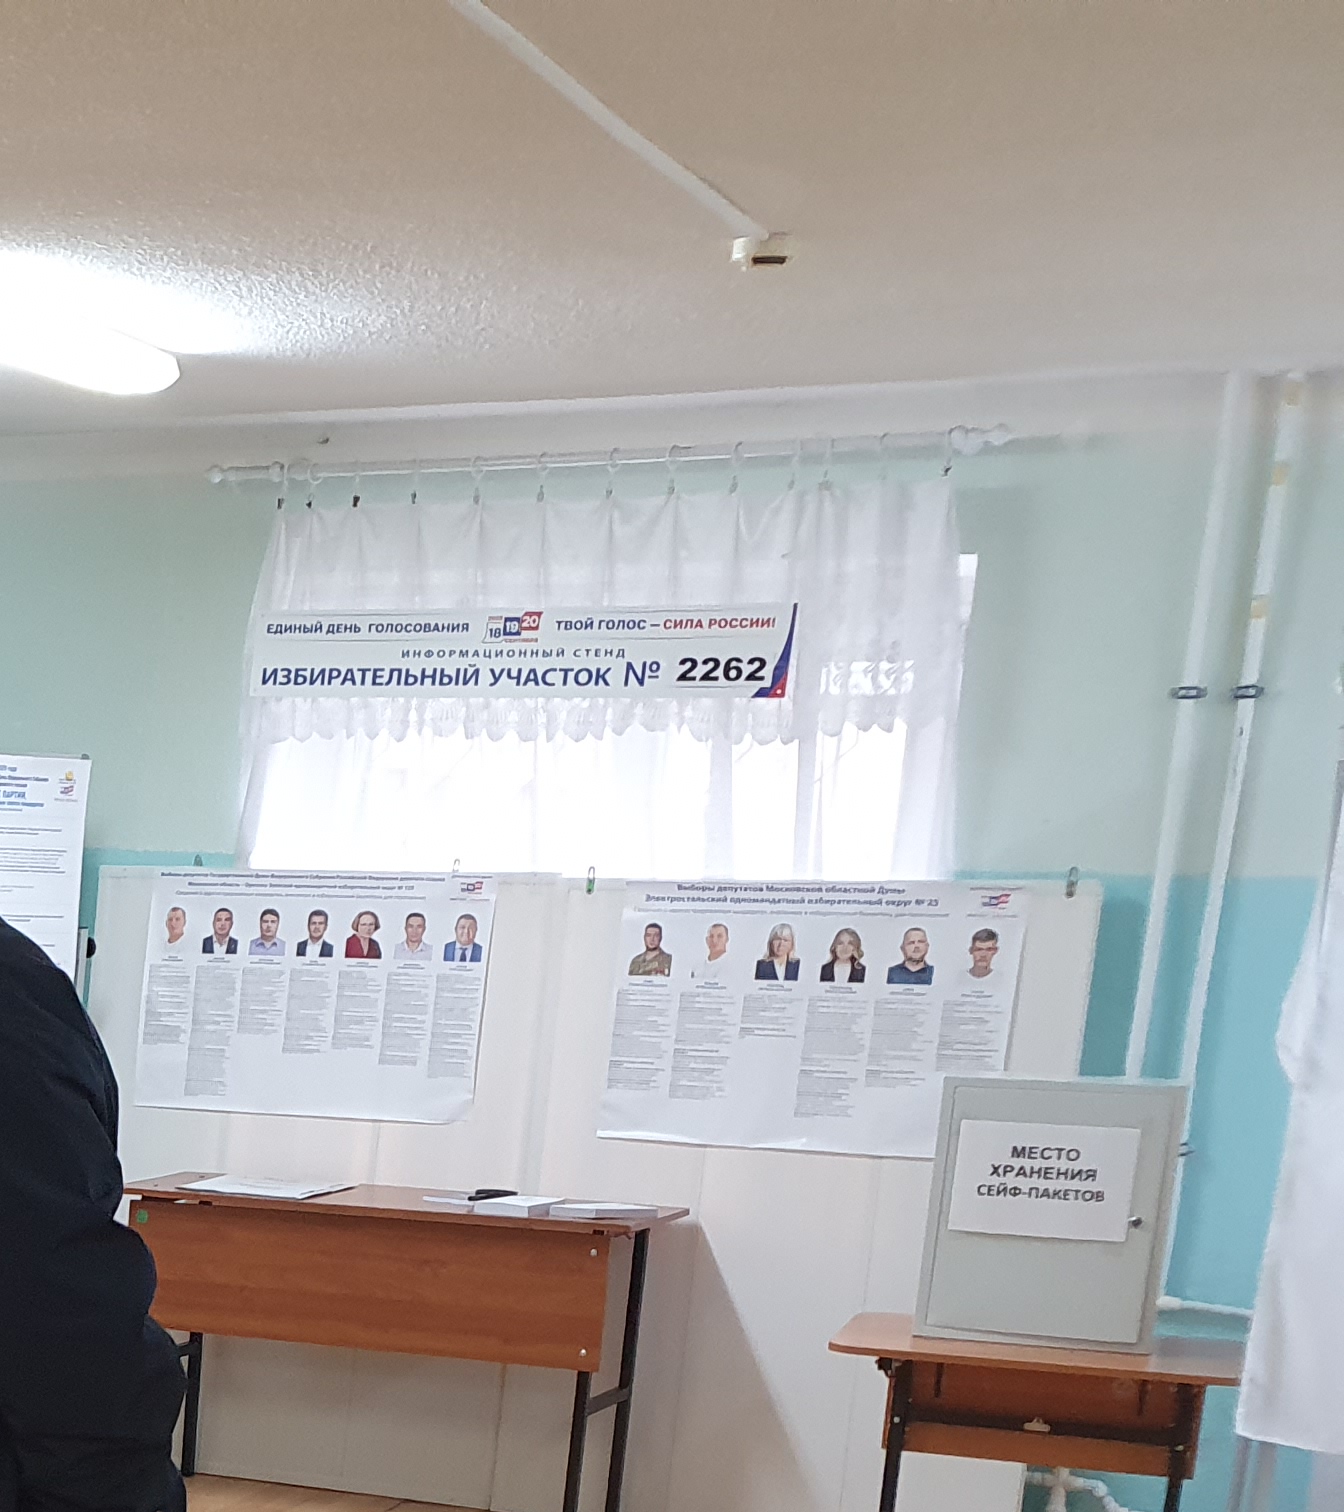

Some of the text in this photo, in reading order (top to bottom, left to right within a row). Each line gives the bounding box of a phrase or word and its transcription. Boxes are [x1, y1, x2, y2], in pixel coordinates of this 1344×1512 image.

[266, 620, 470, 635] ЕДИНЫЙ ДЕНЬ ГОЛОСОВАНИЯ
[505, 621, 519, 633] 19
[521, 615, 539, 628] 20
[555, 617, 594, 631] ТВОЙ
[597, 619, 647, 630] ГОЛОС
[663, 618, 704, 630] СИЛА
[708, 617, 776, 630] РОССИИ!
[489, 627, 502, 638] 18
[401, 647, 626, 660] ИНФОРМАЦИОННЫЙ СТЕНД
[261, 656, 767, 688] ИЗБИРАТЕЛЬНЫЙ УЧАСТОК № 2262
[1010, 1145, 1081, 1162] МЕСТО
[989, 1163, 1098, 1182] ХРАНЕНИЯ
[977, 1182, 1105, 1203] СЕЙФ-ПАКЕТОВ
